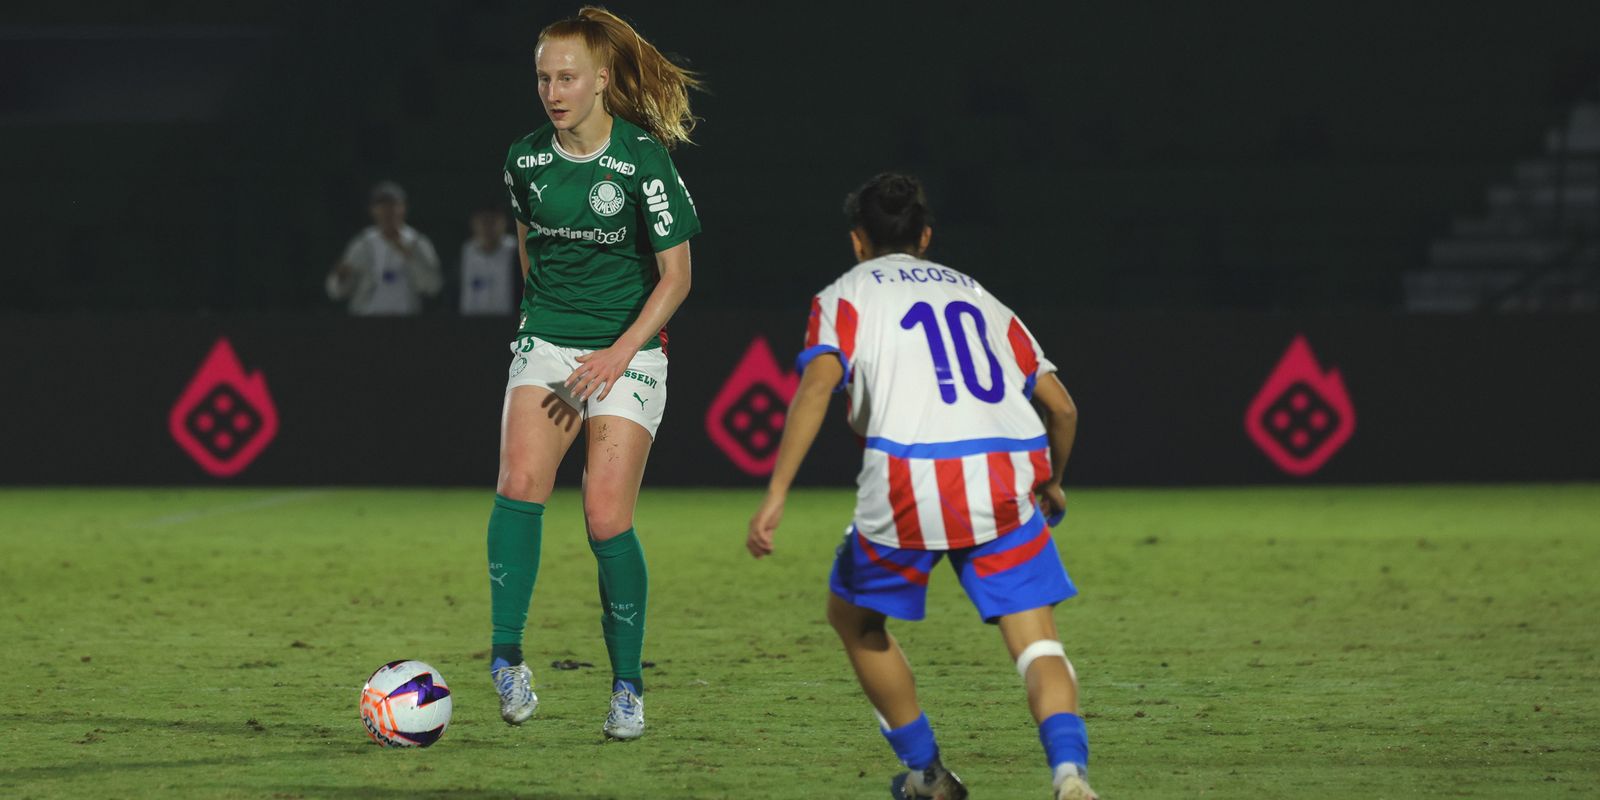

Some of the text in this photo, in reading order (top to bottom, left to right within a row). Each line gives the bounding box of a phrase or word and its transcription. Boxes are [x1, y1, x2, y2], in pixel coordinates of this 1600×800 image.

[599, 155, 636, 176] CIMED
[591, 195, 622, 215] PALMEIRAS
[871, 268, 895, 284] F.
[900, 300, 1005, 405] 10
[622, 370, 657, 389] SSELVI
